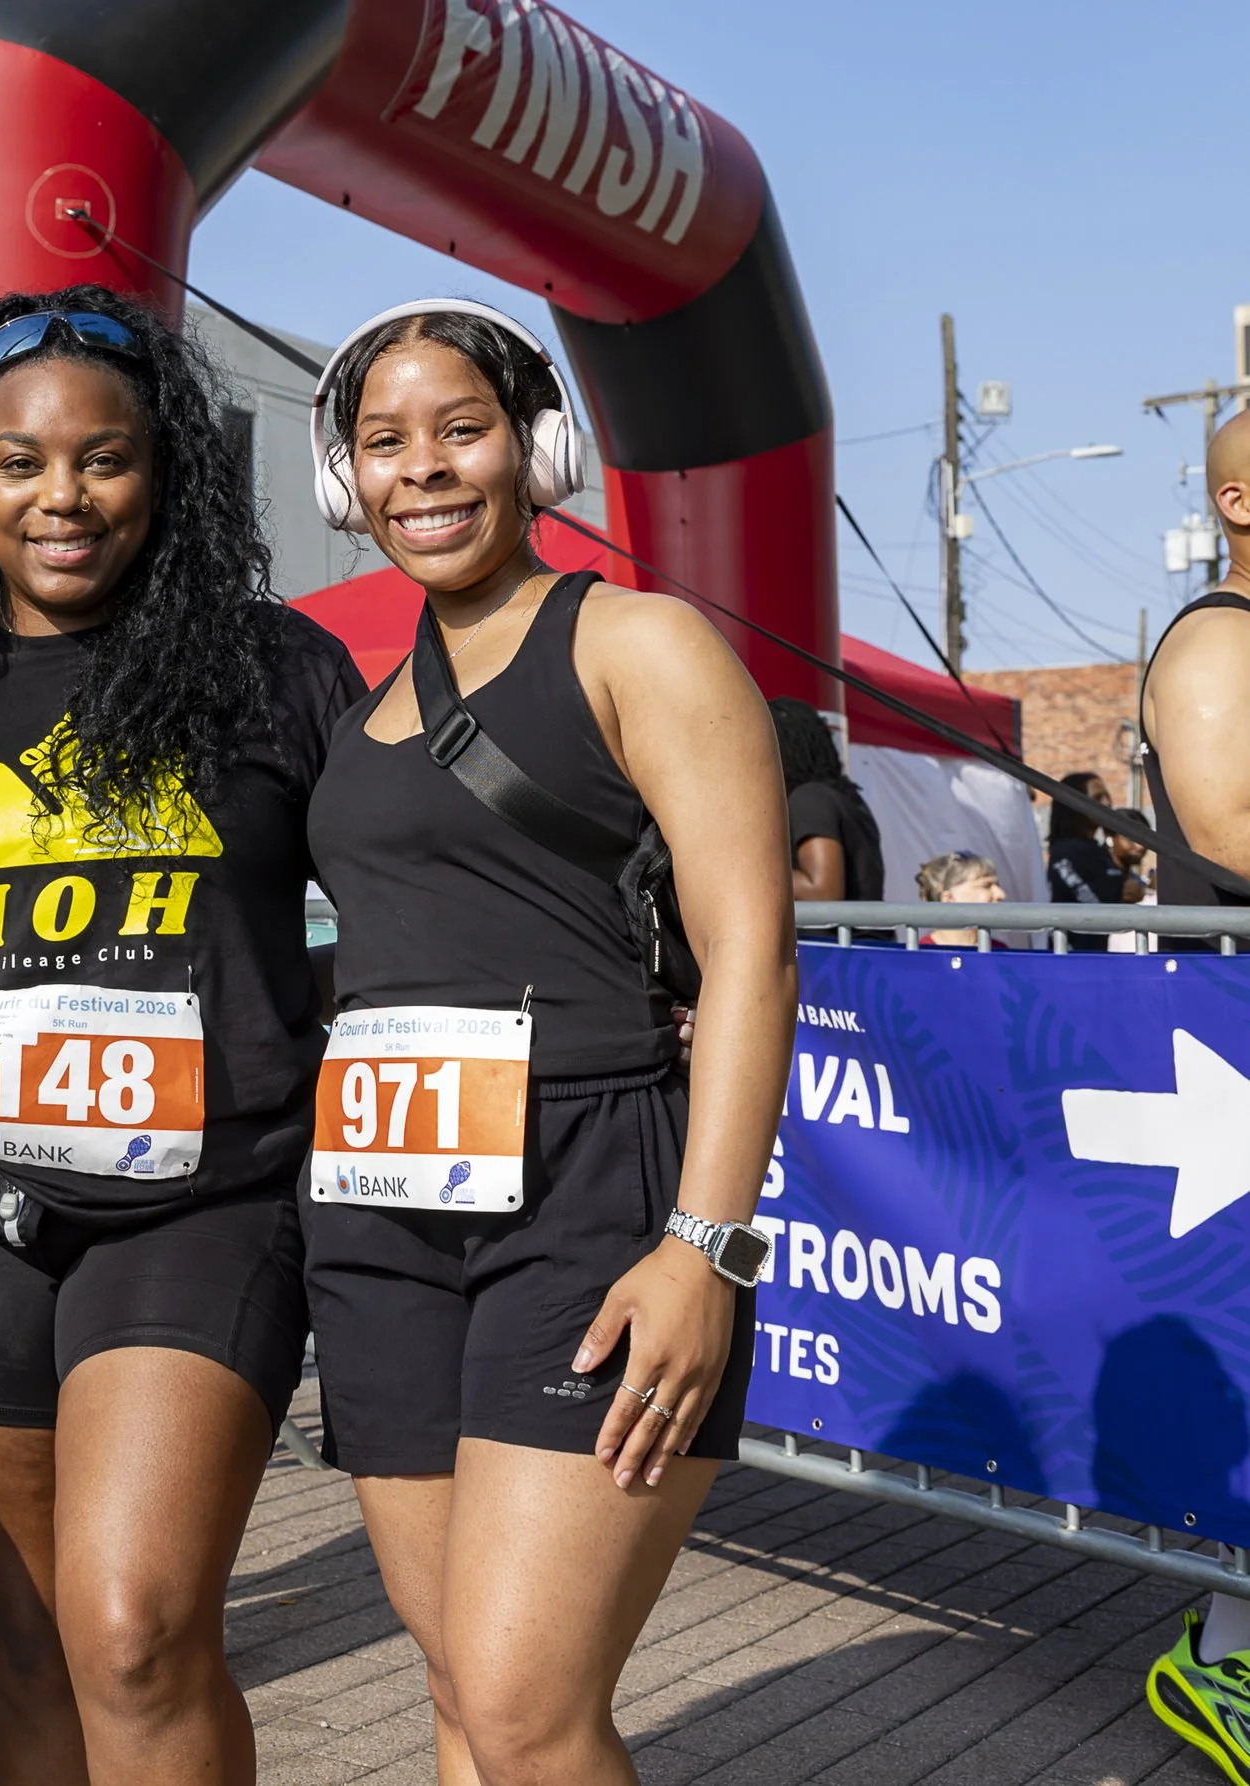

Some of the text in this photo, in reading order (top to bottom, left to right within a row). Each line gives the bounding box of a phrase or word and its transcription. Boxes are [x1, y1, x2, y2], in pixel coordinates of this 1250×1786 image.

[413, 0, 705, 246] FINISH
[98, 945, 154, 962] Club
[29, 995, 50, 1010] du
[57, 995, 130, 1014] Festival
[136, 999, 177, 1015] 2026
[52, 1019, 88, 1029] 5K Run
[339, 1018, 502, 1037] Courir du Festival 2026
[385, 1043, 410, 1051] 5K Run
[782, 1053, 910, 1134] VAL
[341, 1061, 461, 1149] 971
[753, 1320, 840, 1386] TES
